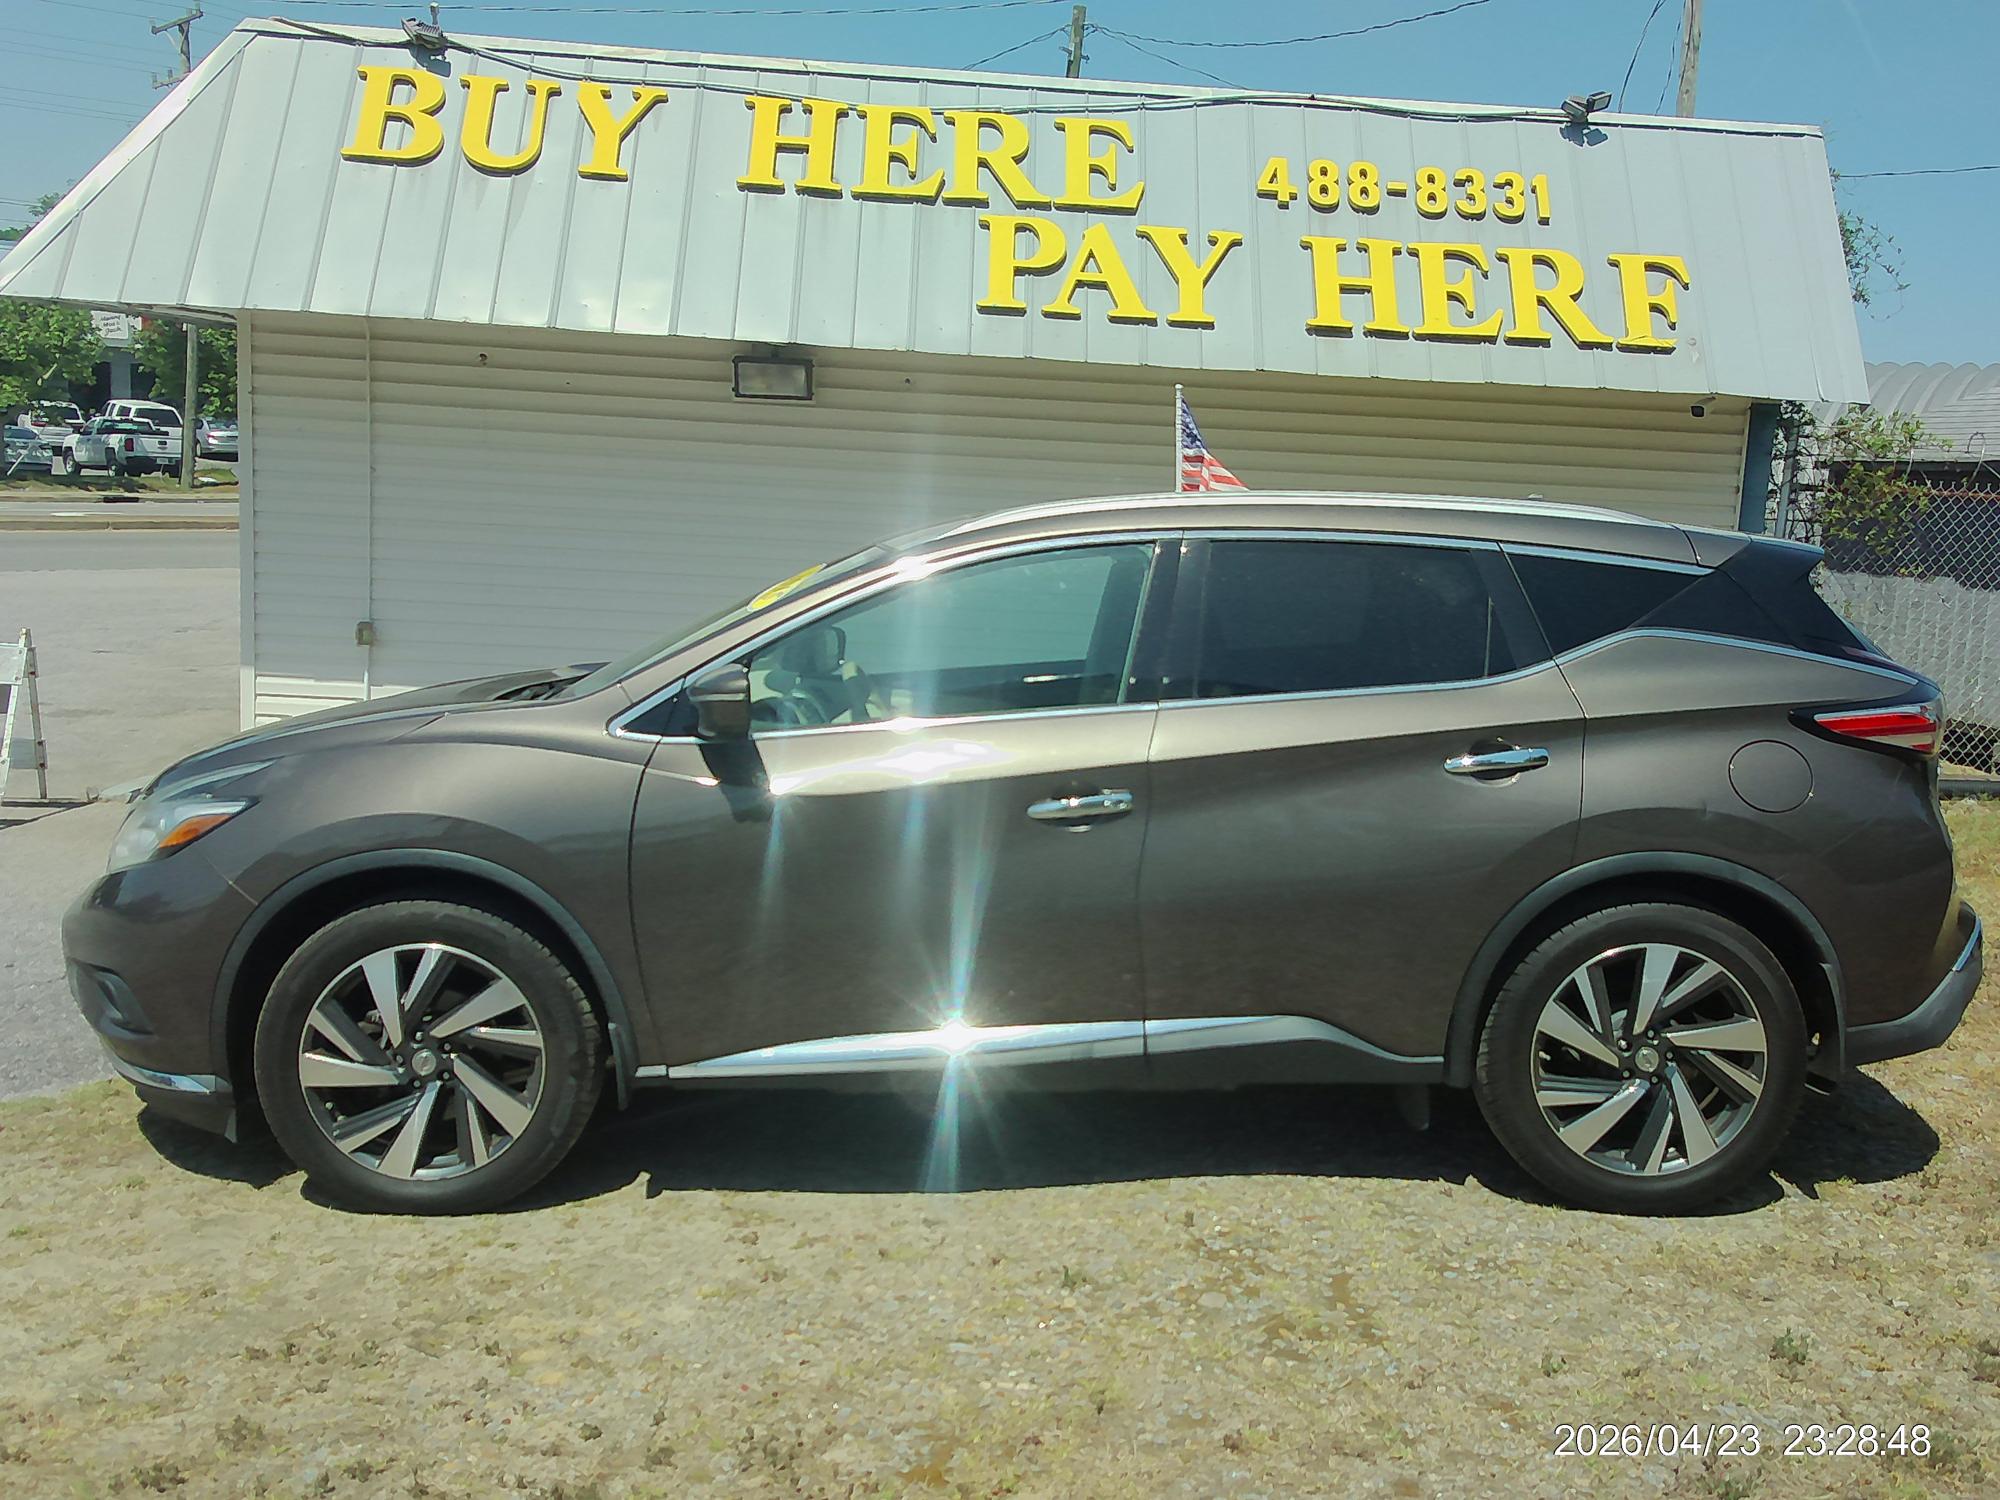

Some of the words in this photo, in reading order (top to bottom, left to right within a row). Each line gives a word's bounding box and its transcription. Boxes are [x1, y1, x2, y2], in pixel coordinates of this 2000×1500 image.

[342, 66, 668, 180] BUY
[738, 96, 1145, 213] HERE
[1257, 157, 1550, 224] 488-8331
[977, 214, 1243, 326] PAY
